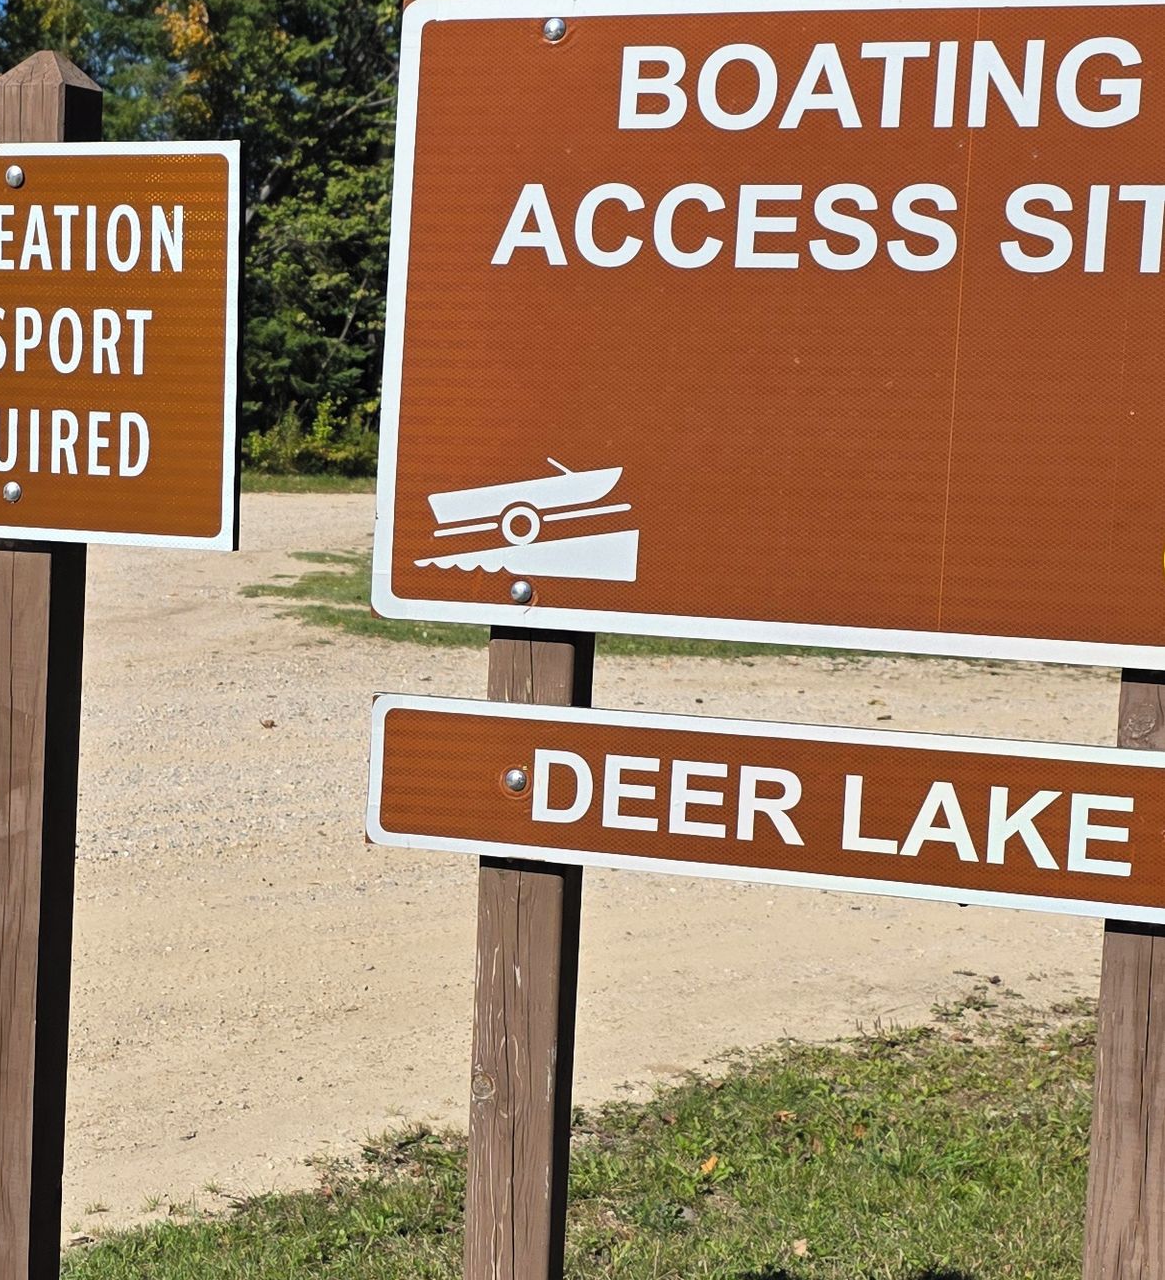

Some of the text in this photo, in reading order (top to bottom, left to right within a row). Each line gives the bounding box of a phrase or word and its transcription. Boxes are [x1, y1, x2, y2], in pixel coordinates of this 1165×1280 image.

[618, 36, 1143, 131] BOATING
[491, 182, 959, 272] ACCESS
[531, 748, 1133, 877] DEER LAKE
